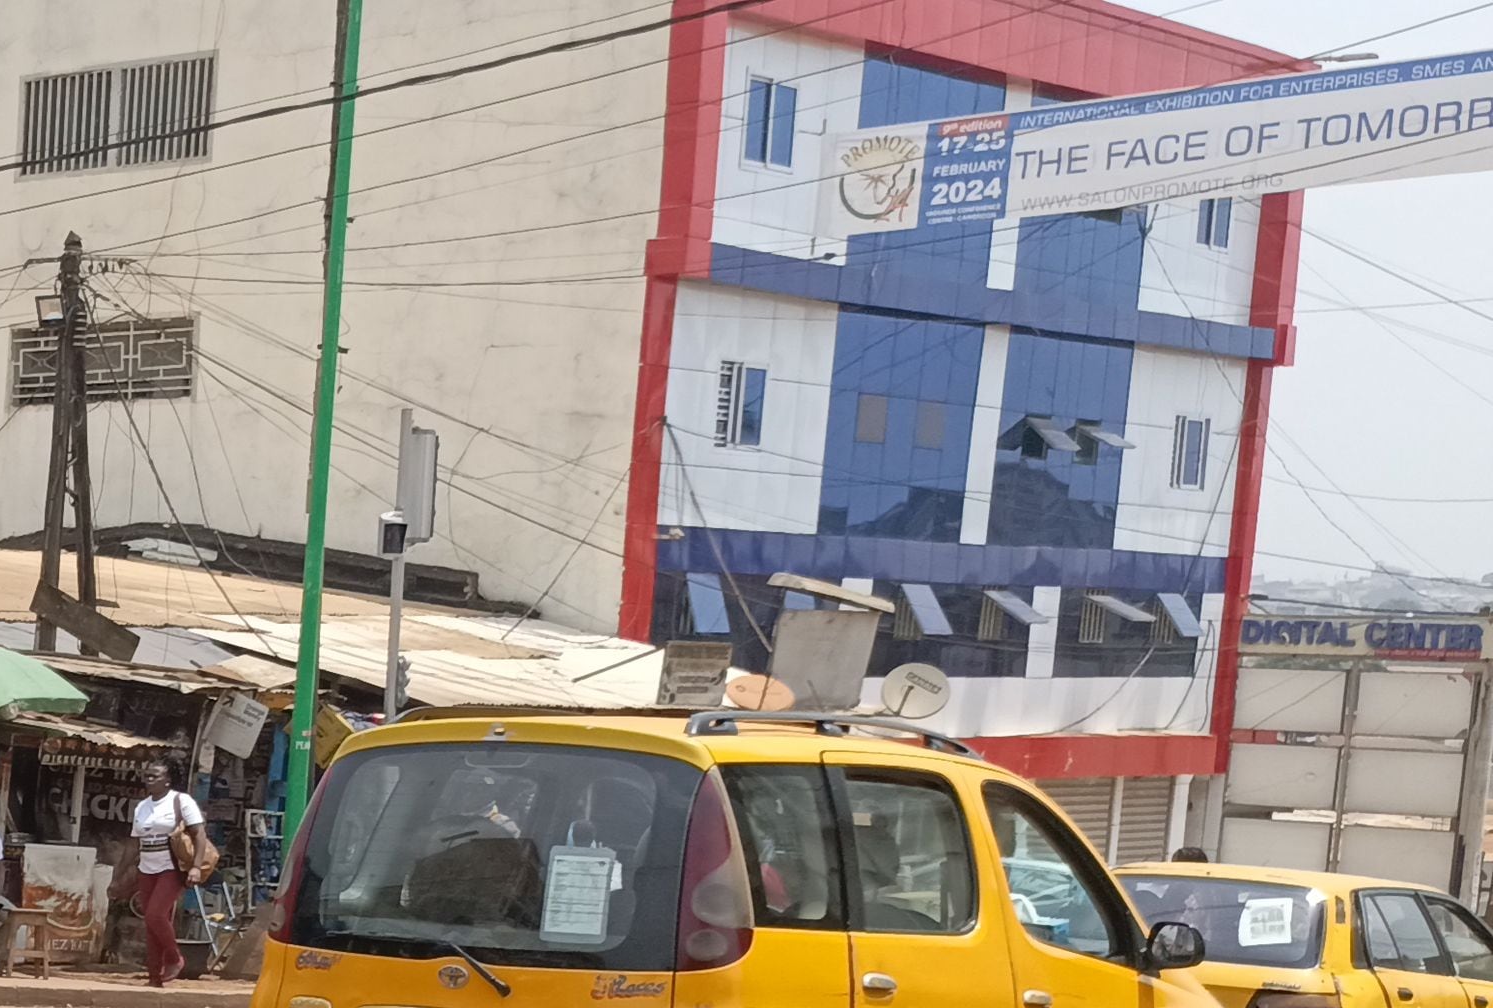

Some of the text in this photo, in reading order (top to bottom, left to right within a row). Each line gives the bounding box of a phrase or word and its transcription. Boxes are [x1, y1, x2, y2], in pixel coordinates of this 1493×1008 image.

[1020, 102, 1140, 127] INTERNATIONAL
[1145, 89, 1234, 113] EXHIBITION
[1240, 84, 1273, 101] FOR
[1279, 68, 1403, 97] ENTERPRISES,
[1411, 59, 1465, 80] SMES
[961, 118, 1003, 133] edition
[840, 135, 922, 167] PROMOTE
[937, 131, 1006, 156] 17-25
[1015, 144, 1090, 179] THE
[1105, 130, 1209, 171] FACE
[1224, 121, 1281, 158] OF
[932, 158, 1007, 178] FEBRUARY
[930, 177, 1002, 206] 2024
[1241, 619, 1484, 650] DIGITAL CENTER
